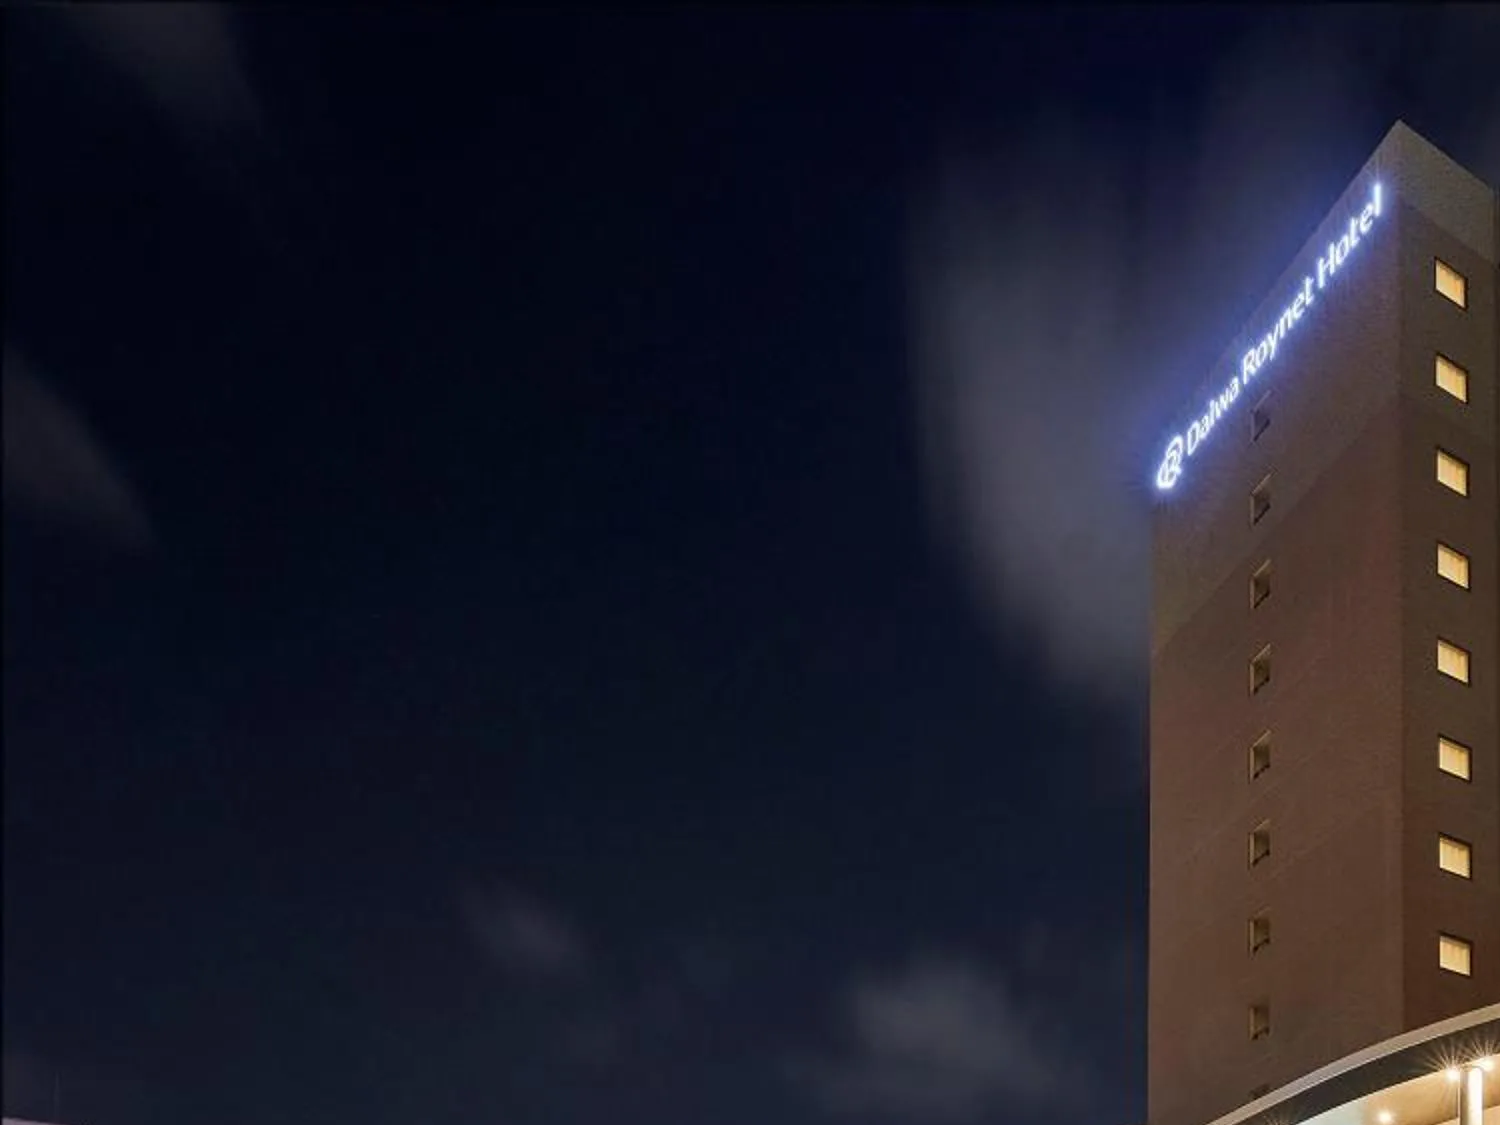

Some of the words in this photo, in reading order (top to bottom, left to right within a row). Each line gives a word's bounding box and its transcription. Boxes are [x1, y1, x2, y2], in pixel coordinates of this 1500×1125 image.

[1187, 376, 1239, 456] Daiwa
[1242, 276, 1315, 384] Roynet
[1317, 182, 1382, 289] Hotel
